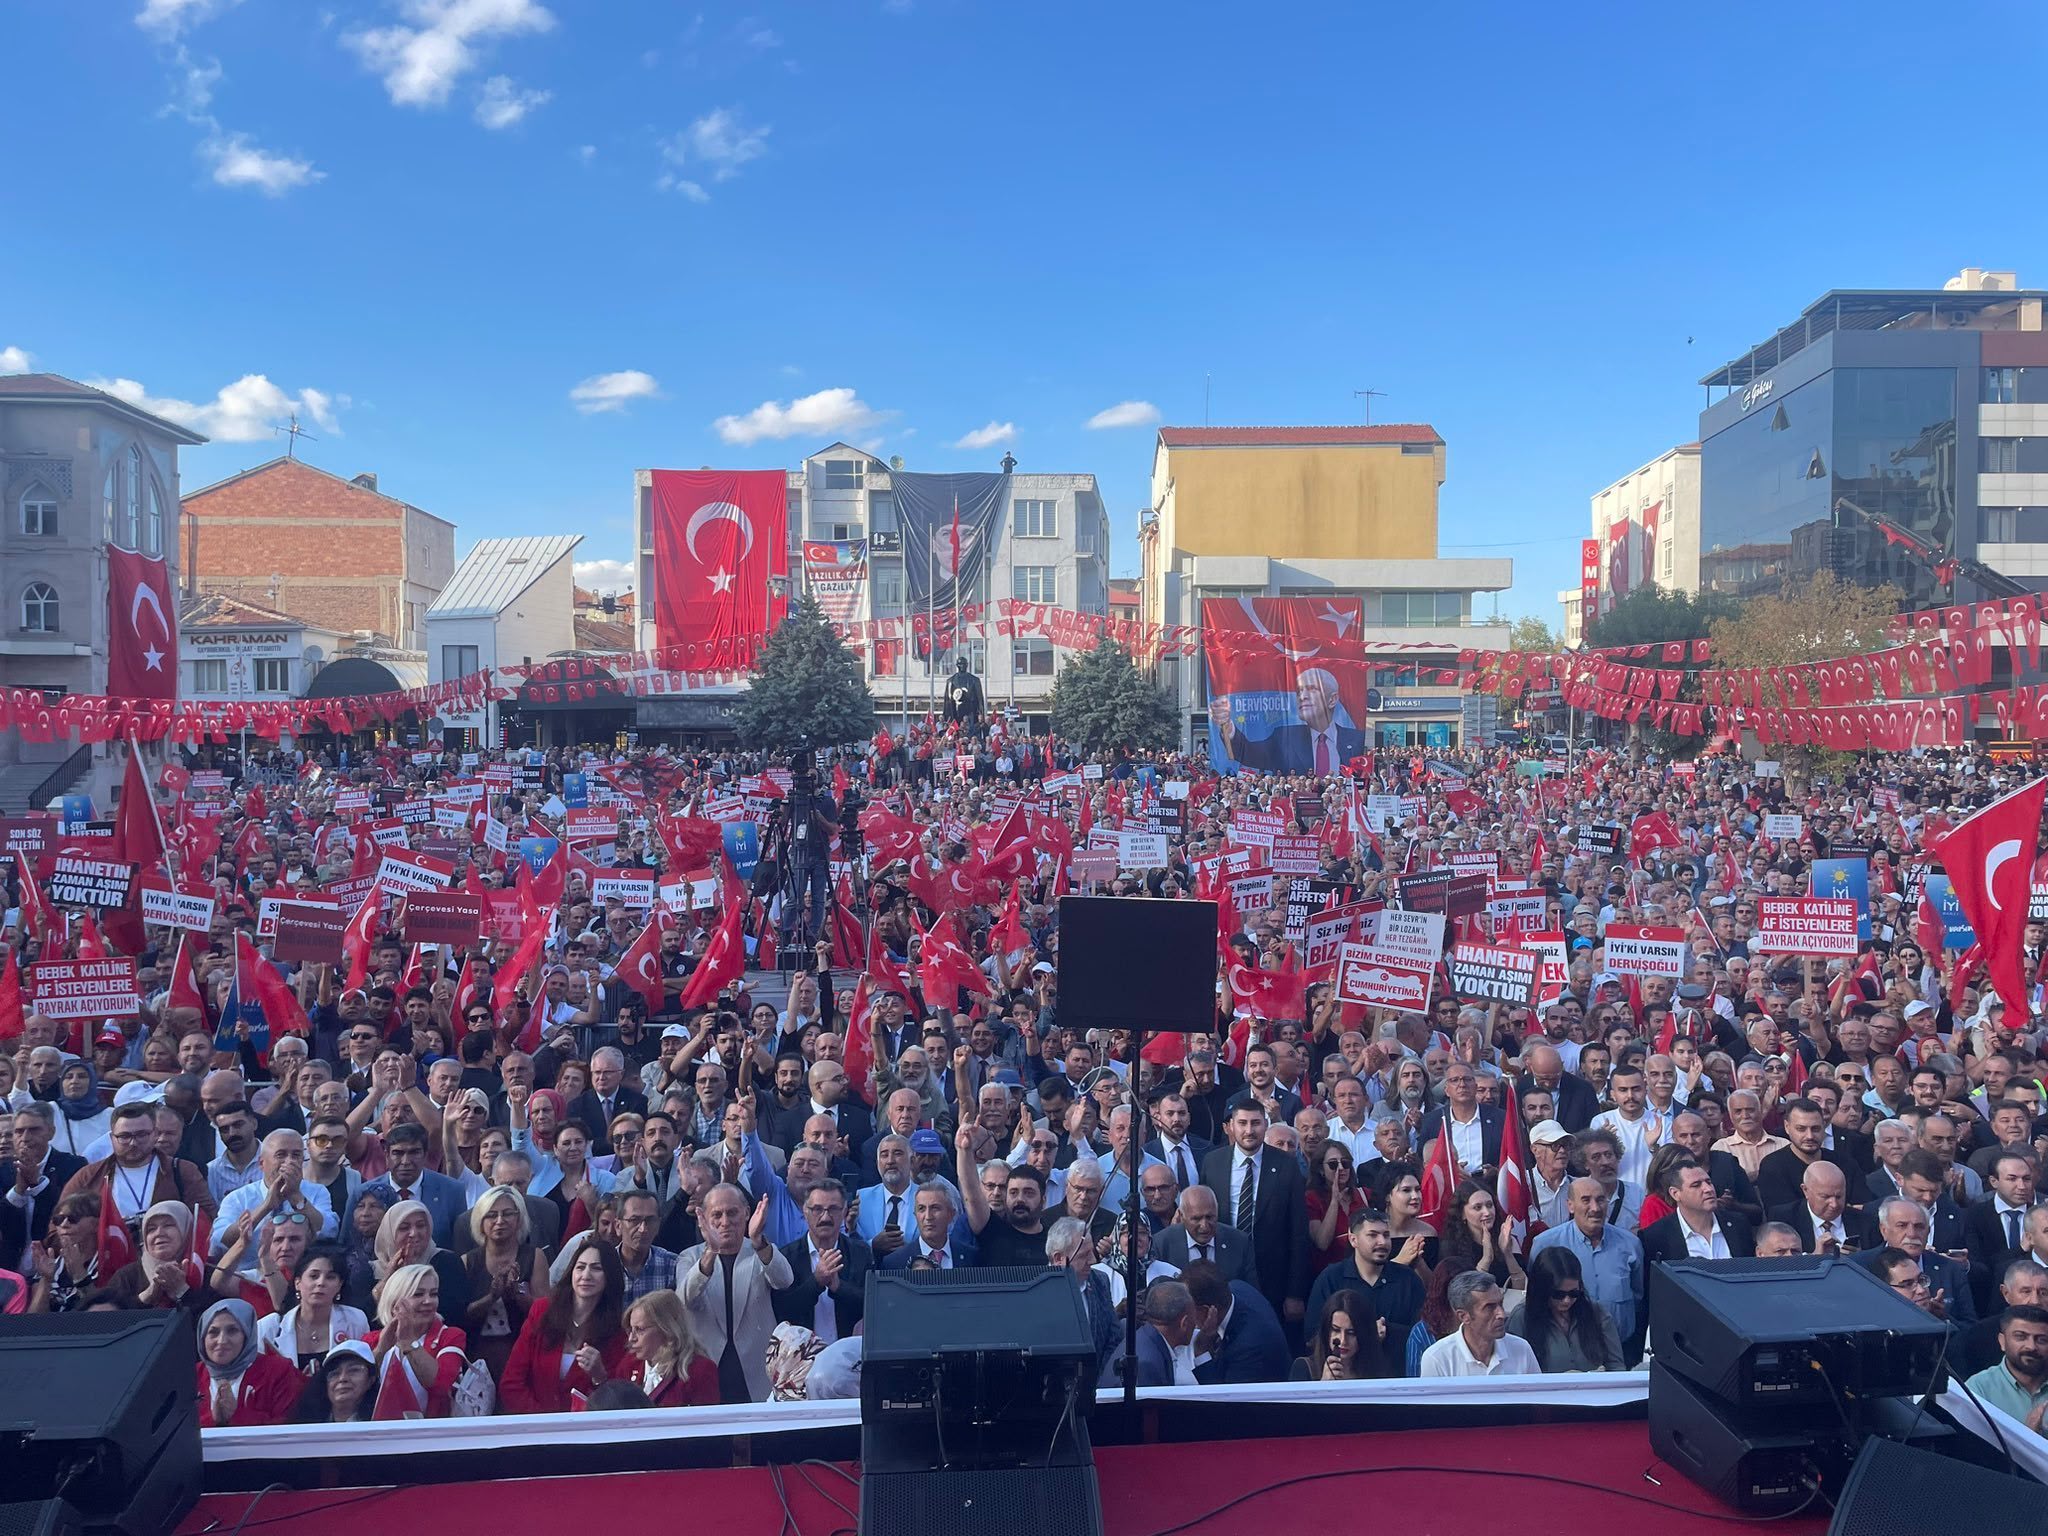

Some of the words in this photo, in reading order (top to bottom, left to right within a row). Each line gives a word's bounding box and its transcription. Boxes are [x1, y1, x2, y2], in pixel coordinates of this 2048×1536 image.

[820, 581, 855, 591] GAZİLİK
[1584, 565, 1598, 617] MHP
[190, 633, 288, 645] KAHRAMAN
[402, 813, 431, 823] OKTUR
[742, 807, 760, 822] BİZ
[1148, 807, 1178, 817] AFFETSEN
[575, 815, 611, 825] HAKSIZLIĞA
[1148, 817, 1160, 825] BEN
[1236, 812, 1257, 822] BEBEK
[1258, 813, 1285, 826] KATİLİNE
[10, 829, 26, 839] SON
[27, 827, 42, 839] SÖZ
[70, 822, 87, 831] SEN
[1148, 825, 1182, 834] AFFETMEM
[1236, 822, 1245, 830] AF
[1245, 822, 1285, 836] İSTEYENLERE
[1579, 824, 1592, 832] SEN
[375, 830, 403, 841] VARSIN
[1578, 830, 1611, 840] AFFETSEN
[6, 840, 41, 851] MİLLETİN
[736, 840, 747, 850] İYİ
[1274, 838, 1294, 848] BEBEK
[1295, 838, 1320, 849] KATİLİNE
[1578, 843, 1614, 854] AFFETMEM
[1273, 848, 1281, 858] AF
[1281, 848, 1319, 859] İSTEYENLERE
[1452, 852, 1498, 864] İHANETİN
[534, 856, 545, 866] İYİ
[55, 857, 131, 879] İHANETİN
[385, 861, 410, 877] İYİ'Kİ
[412, 869, 445, 886] VARSIN
[1455, 867, 1496, 876] ÇERÇEVEMİZ
[53, 872, 94, 887] ZAMAN
[96, 877, 129, 891] AŞIMI
[598, 881, 619, 891] İYİ'Kİ
[620, 883, 649, 892] VARSIN
[1237, 881, 1267, 892] Hepiniz
[1290, 881, 1311, 892] SEN
[1402, 878, 1427, 887] FERMAN
[1428, 874, 1451, 883] SİZİNSE
[51, 884, 124, 907] YOKTUR
[330, 884, 353, 895] BEBEK
[1832, 886, 1849, 899] İYİ
[145, 892, 171, 907] İYİ'Kİ
[1246, 892, 1270, 911] TEK
[1943, 899, 1960, 912] İYİ
[269, 902, 279, 913] Si
[408, 903, 455, 914] Çerçevesi
[456, 906, 479, 915] Yasa
[1288, 905, 1308, 916] BEN
[1498, 902, 1509, 912] Siz
[1763, 902, 1800, 914] BEBEK
[1804, 900, 1853, 917] KATİLİNE
[143, 909, 206, 927] DERVİŞOĞLU
[280, 916, 321, 929] Çerçevesi
[322, 922, 344, 931] Yasa
[1390, 912, 1402, 923] HER
[1402, 914, 1428, 924] SEVR'İN
[1494, 912, 1511, 933] Bİ
[1520, 913, 1544, 931] TEK
[1762, 917, 1777, 930] AF
[1779, 914, 1853, 932] İSTEYENLERE
[1316, 925, 1333, 939] Siz
[1388, 923, 1400, 933] BİR
[1400, 925, 1426, 937] LOZAN'I,
[1385, 934, 1398, 942] HER
[1398, 934, 1428, 945] TEZGÂHIN
[1762, 933, 1800, 946] BAYRAK
[1801, 935, 1855, 950] AÇIYORUM!
[1309, 938, 1340, 966] BİZ
[1610, 941, 1638, 954] İYİ'Kİ
[1640, 945, 1678, 957] VARSIN
[1345, 949, 1372, 961] BİZİM
[1374, 953, 1433, 971] ÇERÇEVEMİZ
[1456, 945, 1535, 971] İHANETİN
[36, 964, 75, 980] BEBEK
[80, 960, 132, 977] KATİLİNE
[1543, 962, 1567, 981] EK
[1608, 957, 1679, 973] DERVİŞOĞLU
[1454, 962, 1496, 979] ZAMAN
[1498, 969, 1533, 985] AŞIMI
[37, 983, 52, 997] AF
[55, 978, 133, 996] İSTEYENLERE
[1349, 978, 1420, 998] CUMHURİYETİMİZ
[1453, 975, 1528, 1003] YOKTUR
[37, 999, 79, 1015] BAYRAK
[80, 996, 136, 1014] AÇIYORUM!
